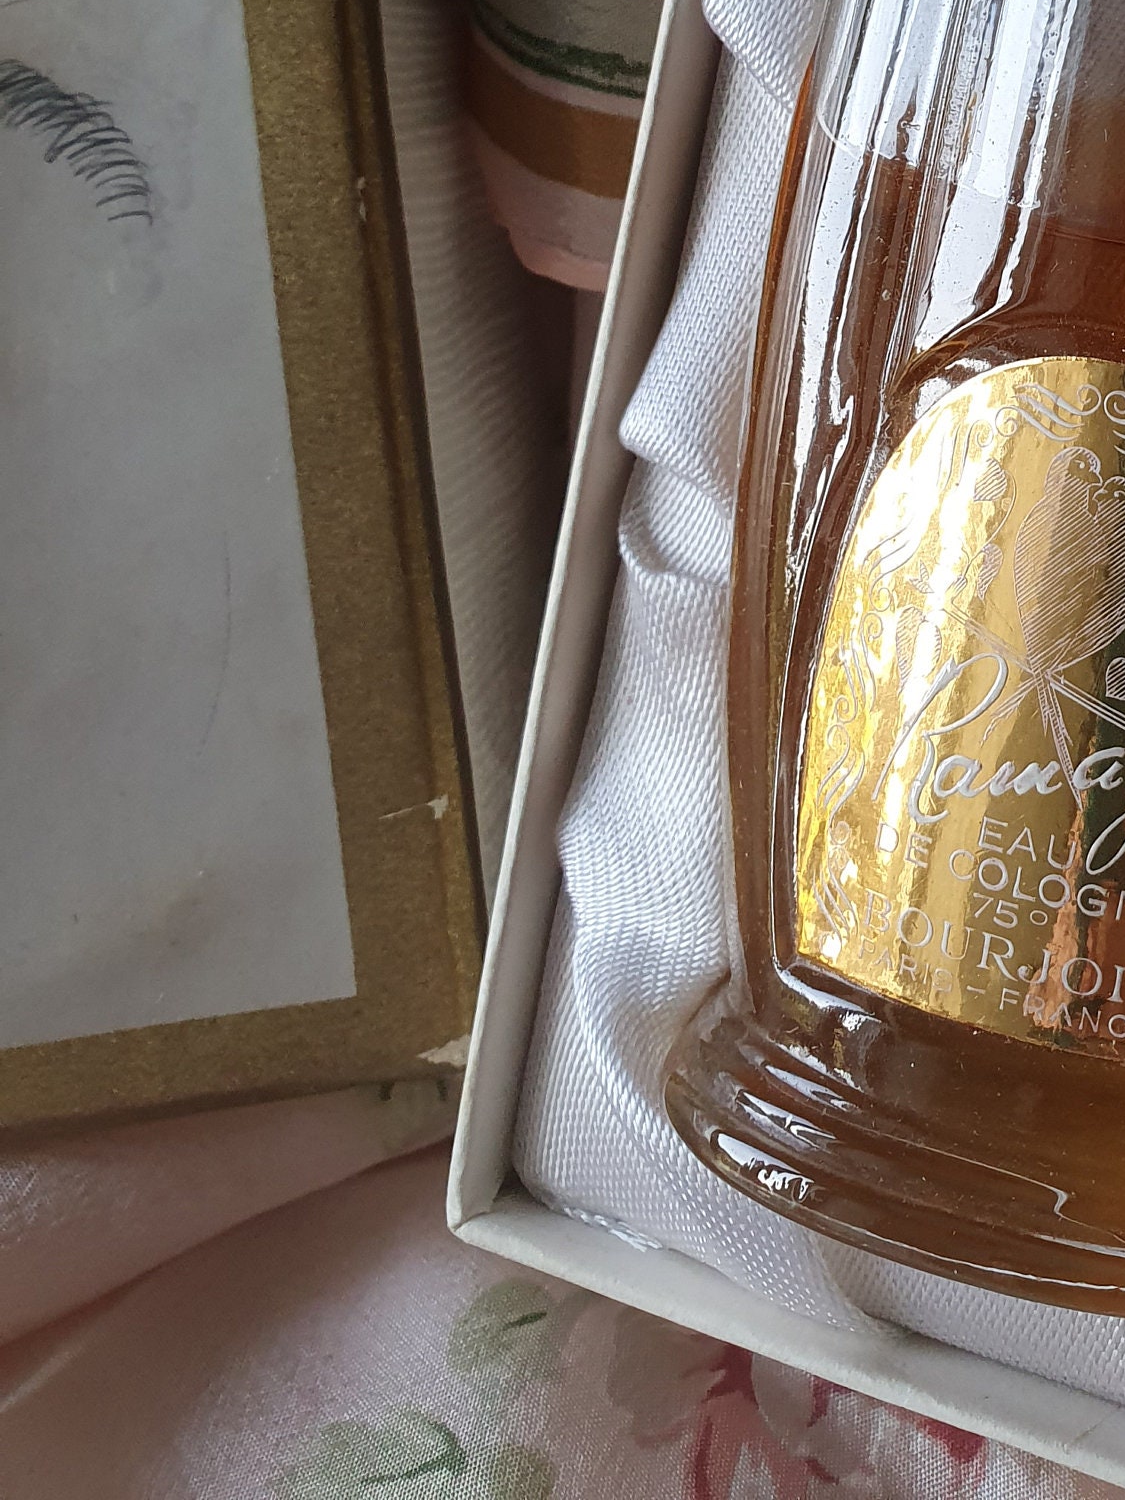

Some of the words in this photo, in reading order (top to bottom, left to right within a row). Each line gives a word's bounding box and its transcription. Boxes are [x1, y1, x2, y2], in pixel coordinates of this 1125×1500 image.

[877, 822, 933, 869] DE
[978, 816, 1076, 870] EAU
[858, 936, 954, 994] PARIS
